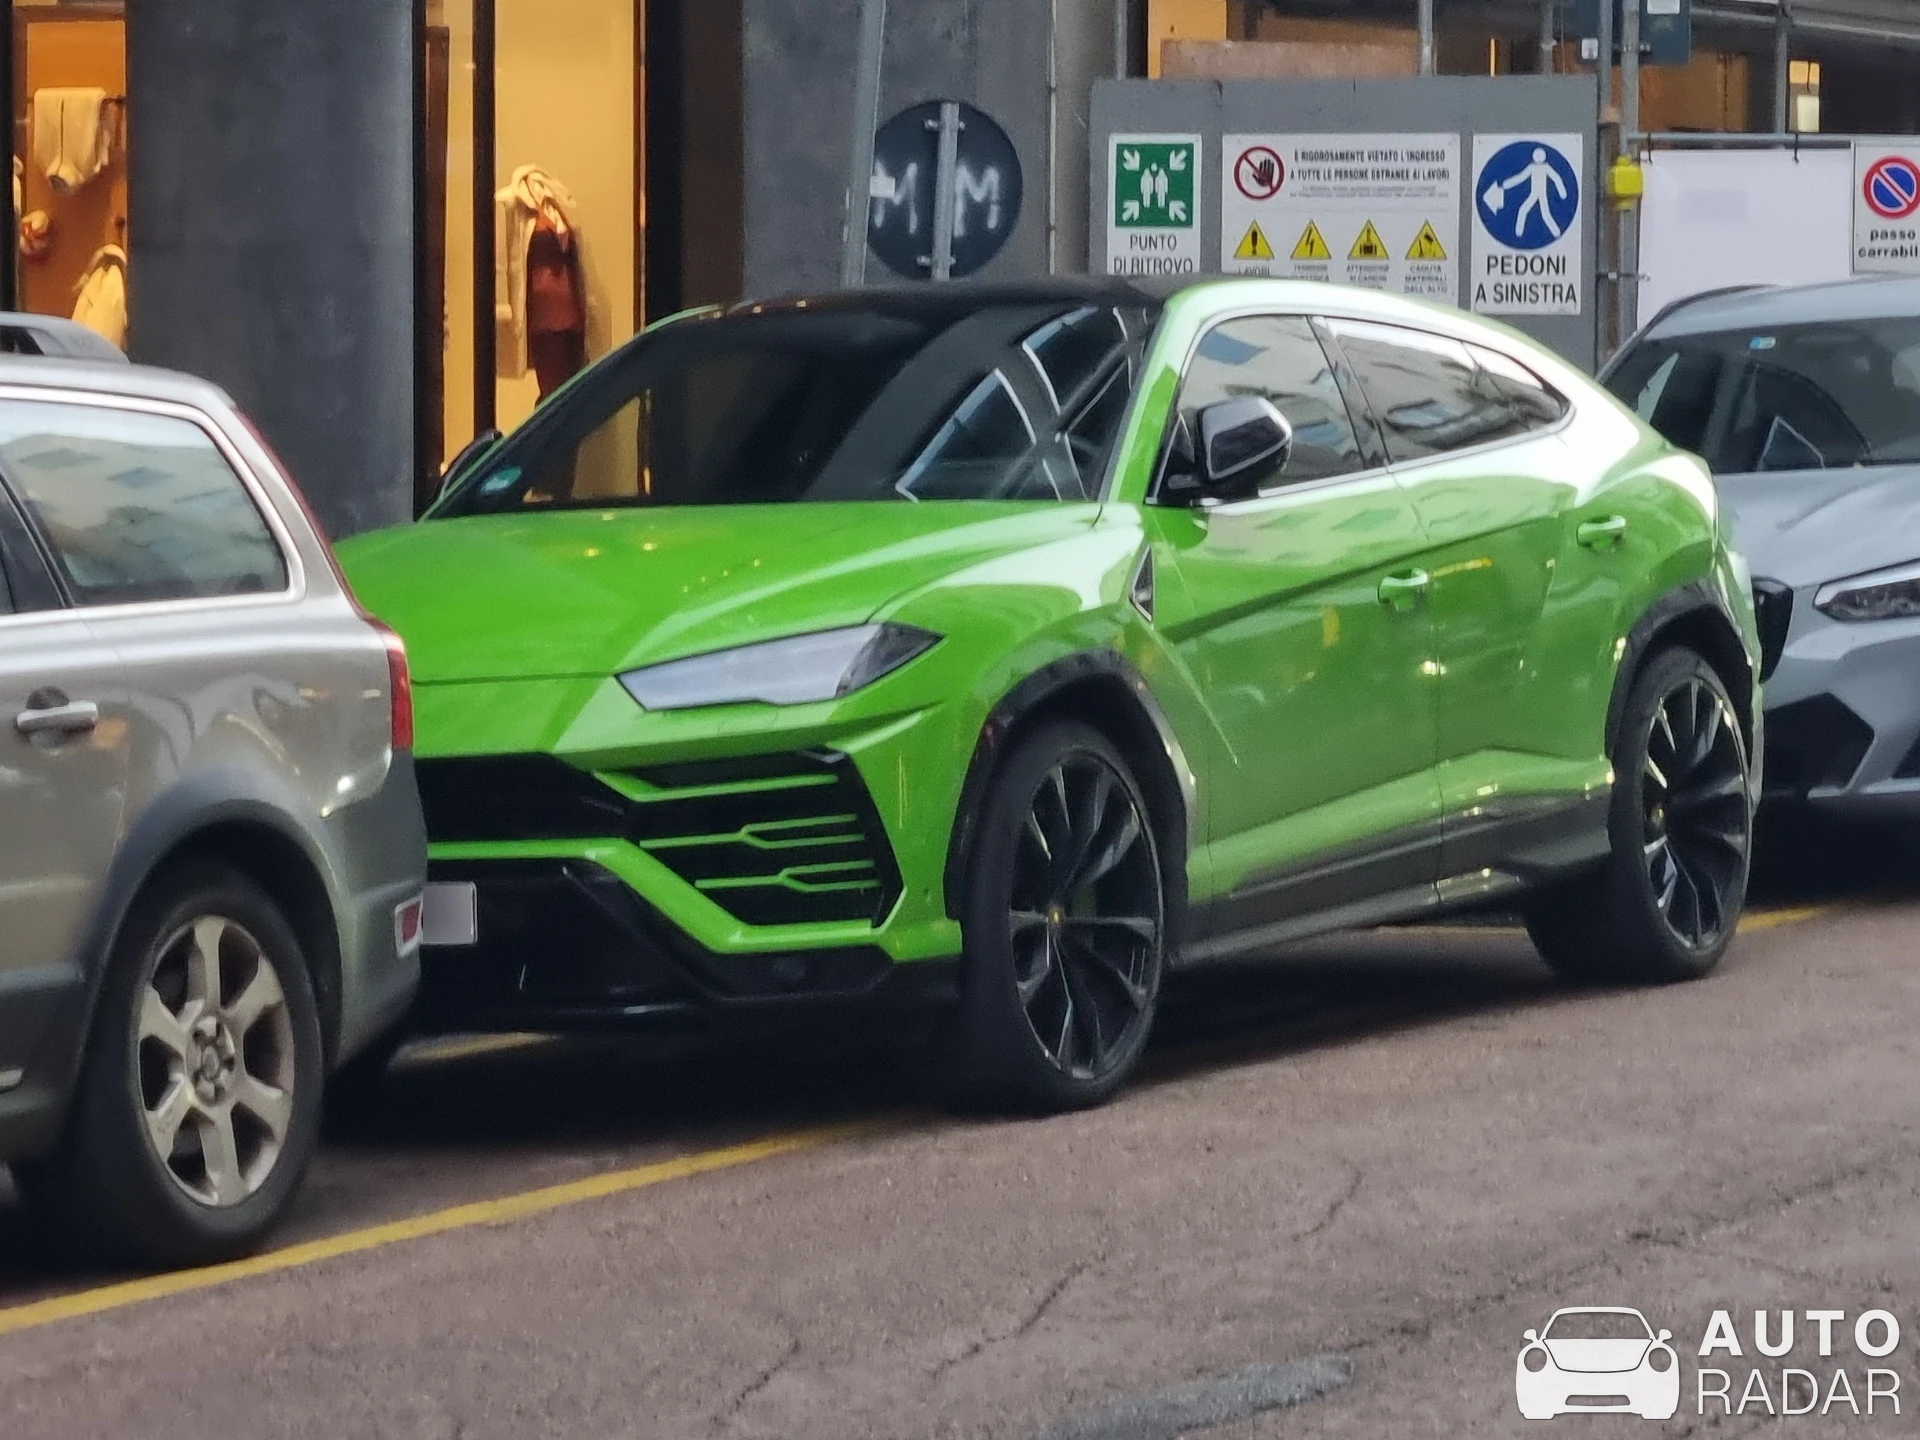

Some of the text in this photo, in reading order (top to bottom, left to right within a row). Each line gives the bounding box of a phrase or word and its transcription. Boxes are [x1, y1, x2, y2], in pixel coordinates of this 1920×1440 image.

[1301, 149, 1364, 163] RIGOROSAMENTE
[1367, 149, 1398, 162] VIETATO
[1400, 149, 1446, 162] L'INGRESSO
[1290, 168, 1450, 181] A TUTTE LE PERSONE ESTRANEE AI LAVORI
[1129, 233, 1177, 251] PUNTO
[1870, 229, 1916, 242] passo
[1113, 257, 1193, 275] DI RITROVO
[1486, 254, 1566, 276] PEDONI
[1474, 282, 1577, 304] A SINISTRA
